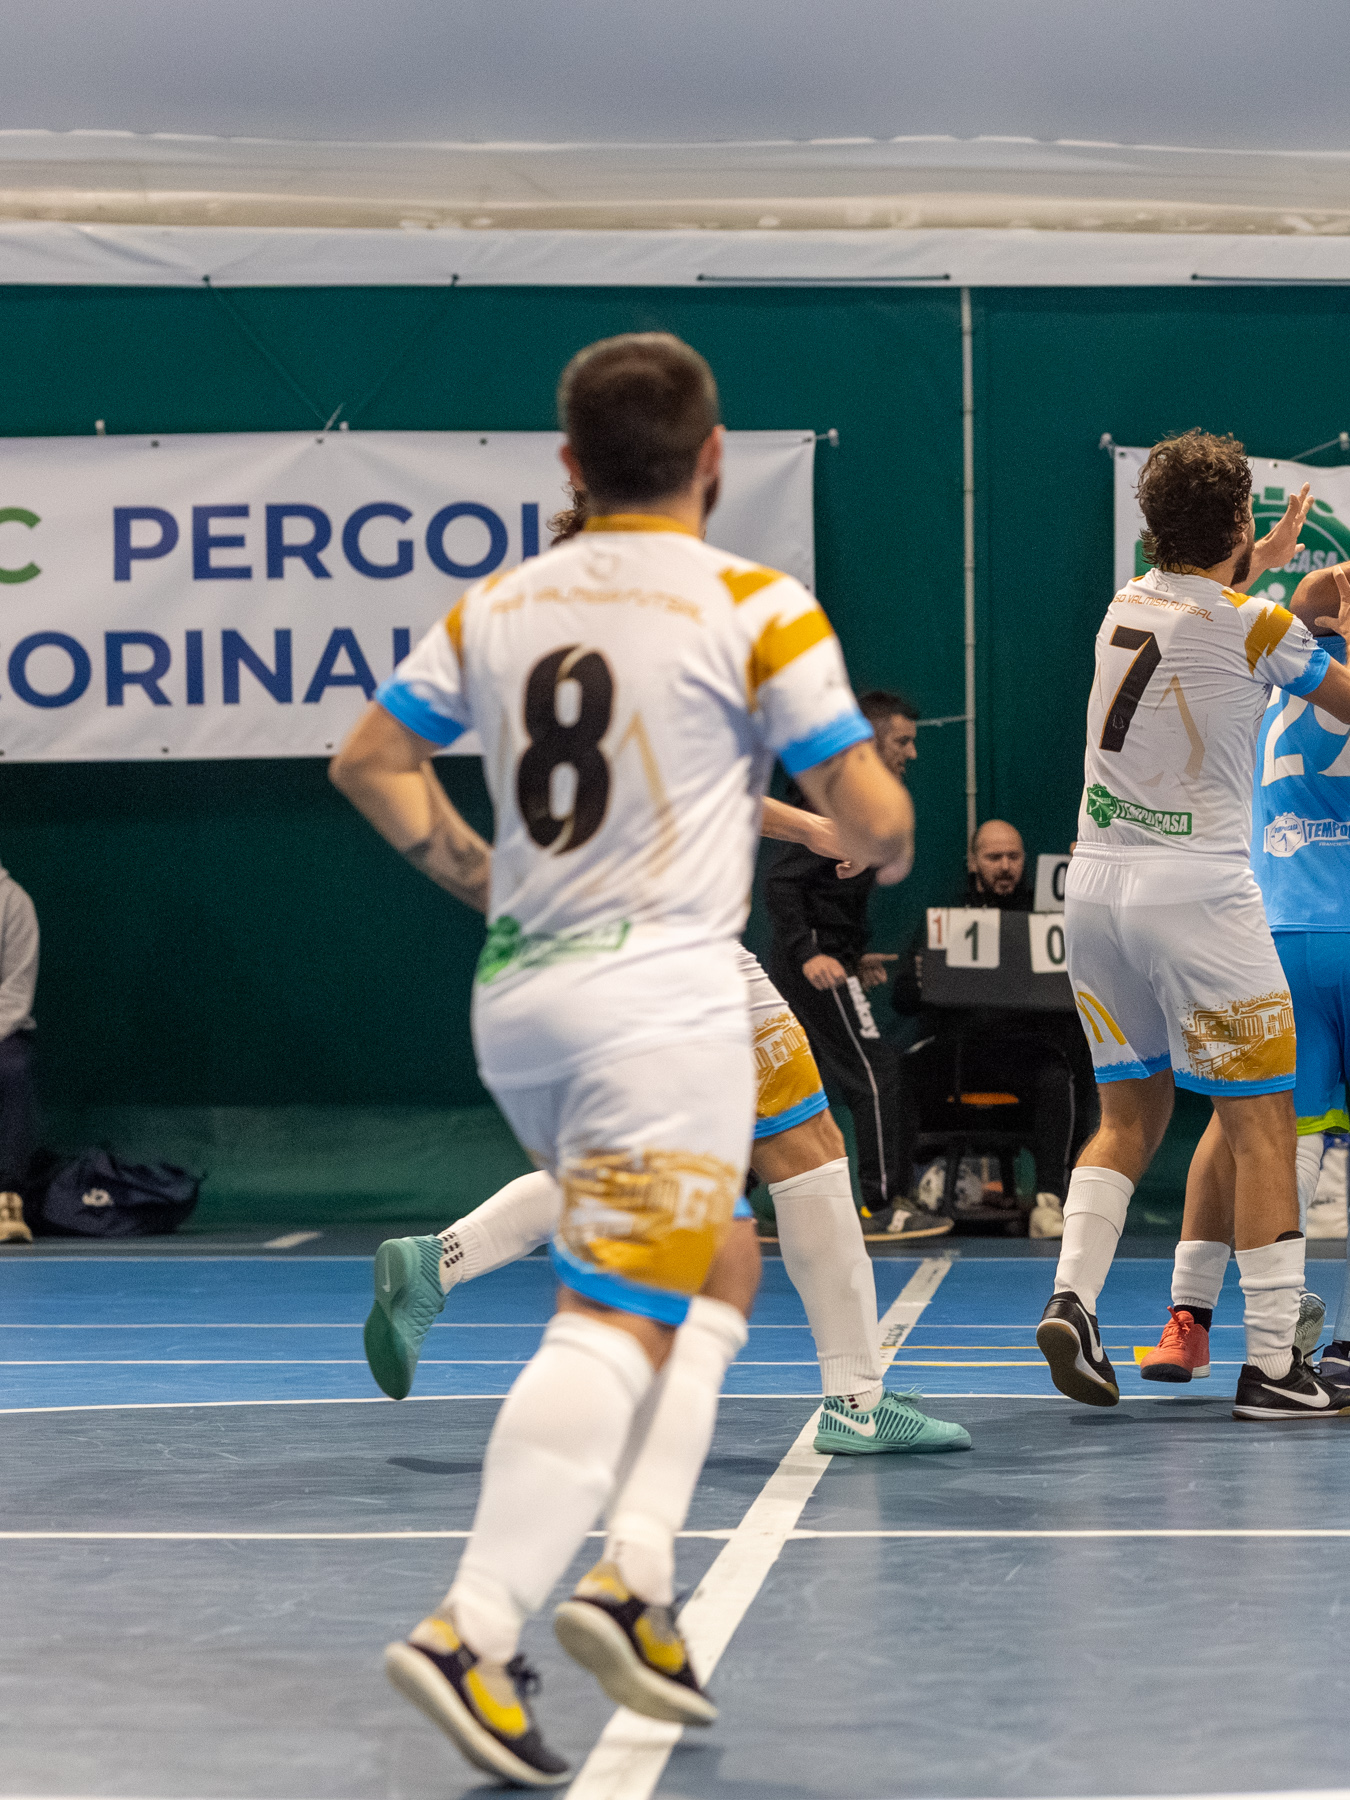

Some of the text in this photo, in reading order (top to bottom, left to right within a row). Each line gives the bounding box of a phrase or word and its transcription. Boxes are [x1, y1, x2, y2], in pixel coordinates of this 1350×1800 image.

[1167, 600, 1214, 622] FUTSAL
[0, 627, 411, 709] ORINA
[1099, 625, 1162, 752] 7
[515, 642, 618, 859] 8
[1119, 801, 1189, 833] TEMPOCASA
[964, 920, 979, 962] 1
[1046, 924, 1066, 966] 0
